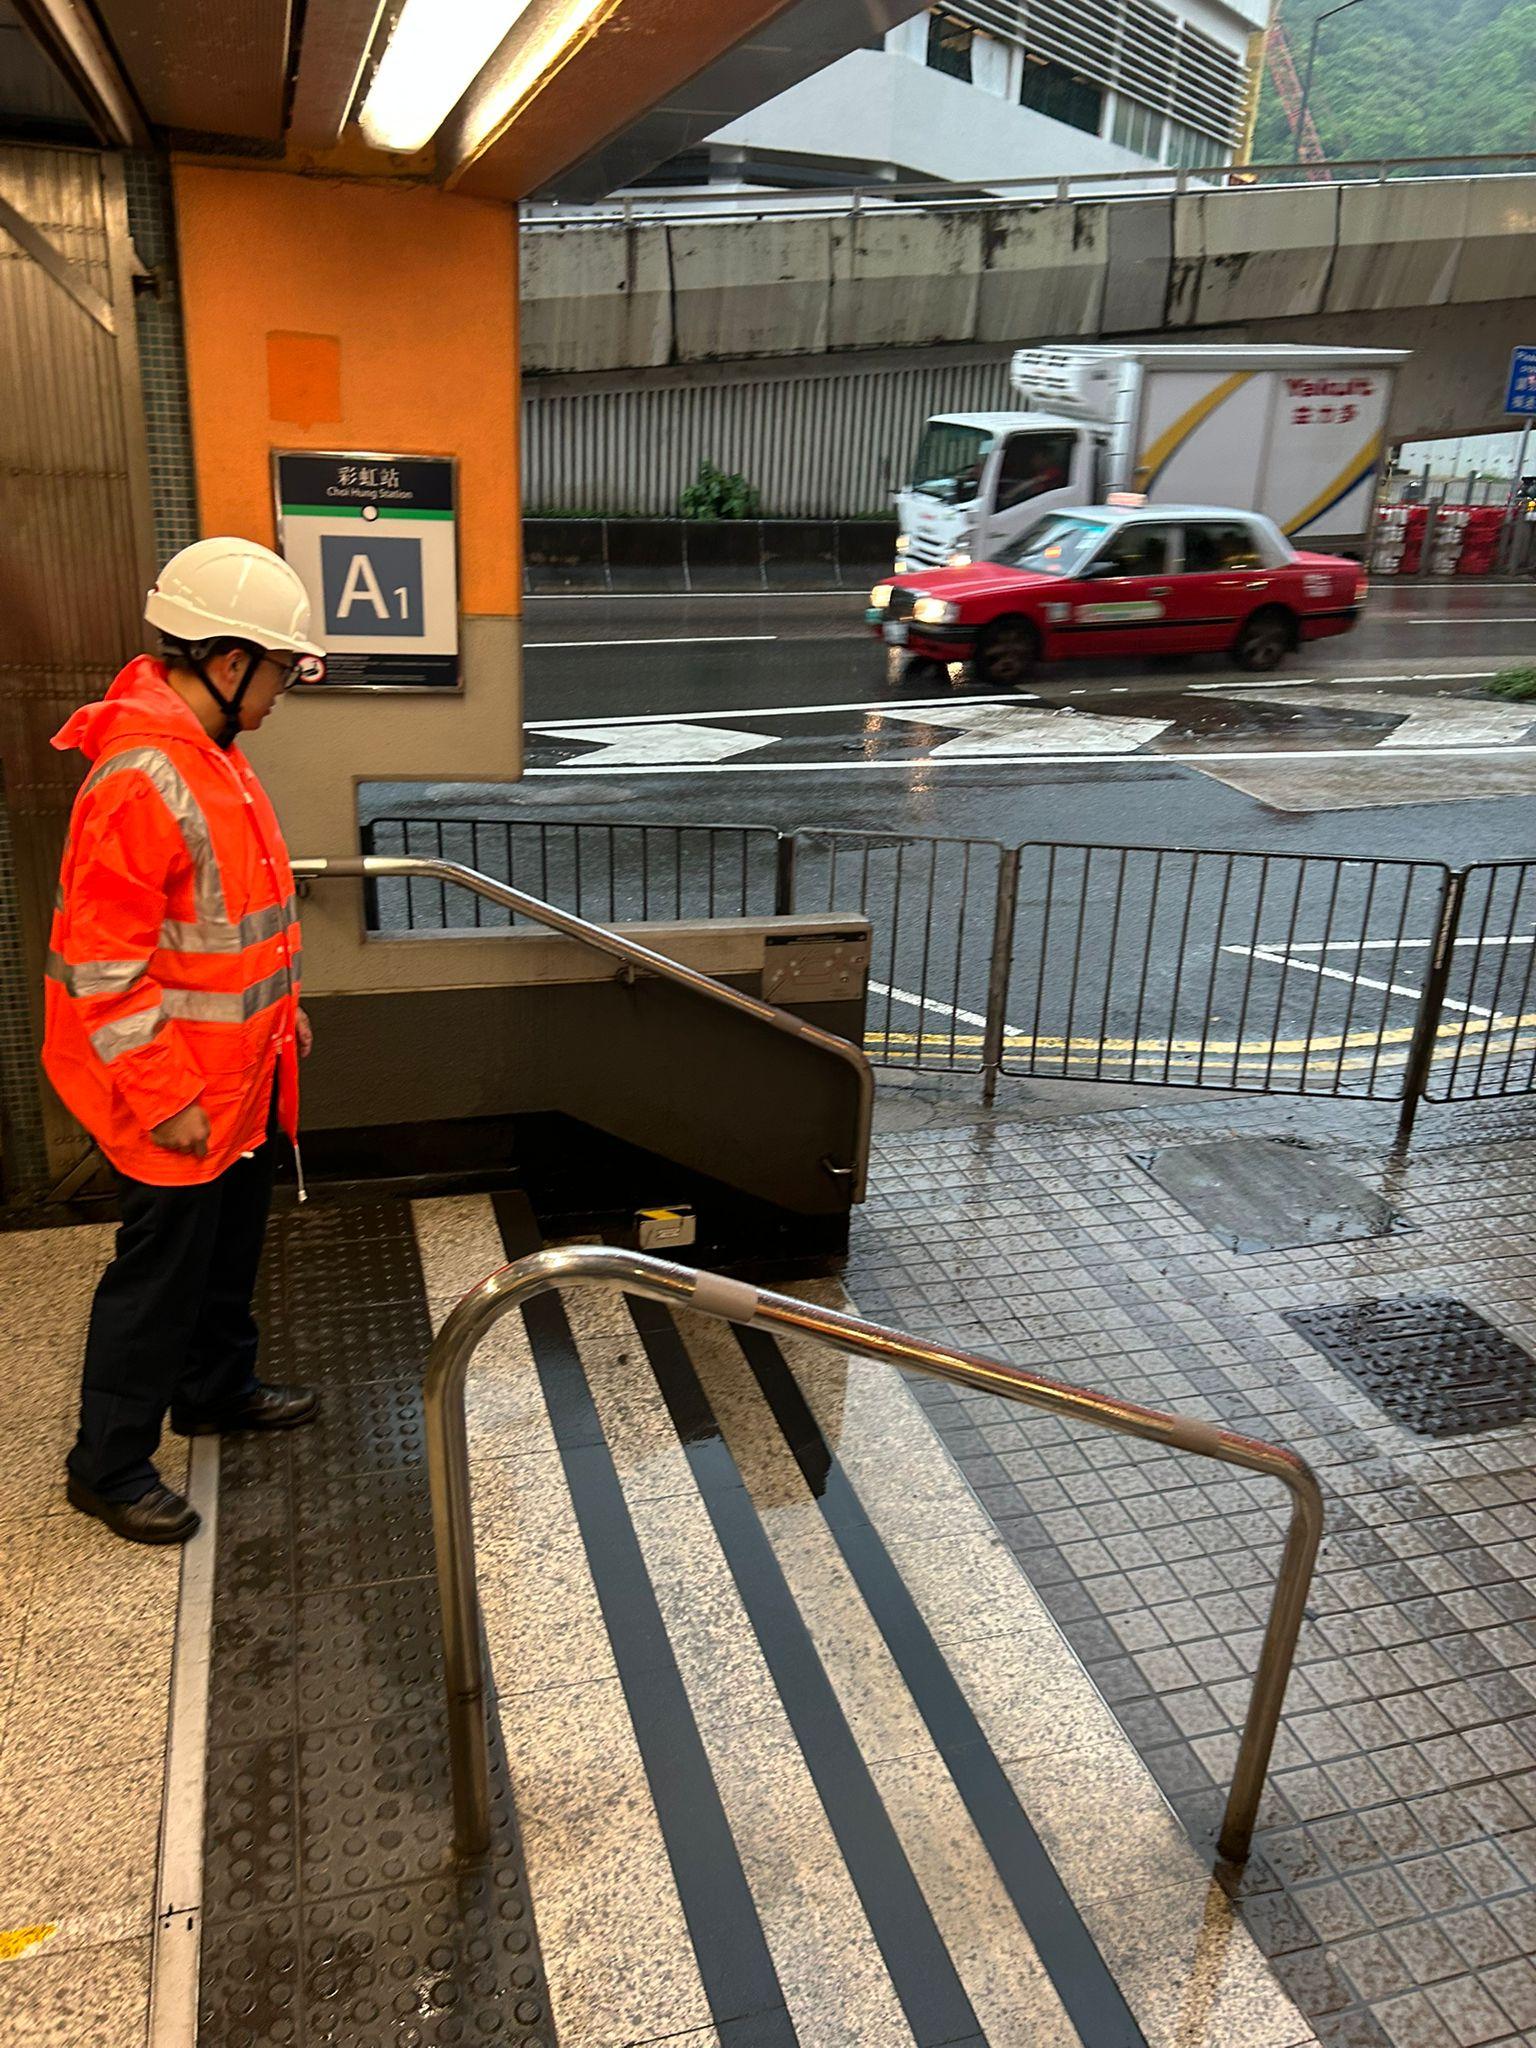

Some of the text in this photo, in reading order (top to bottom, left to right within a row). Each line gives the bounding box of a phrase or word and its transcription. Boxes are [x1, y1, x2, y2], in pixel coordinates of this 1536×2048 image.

[337, 466, 400, 488] 彩虹站
[378, 488, 414, 499] Station
